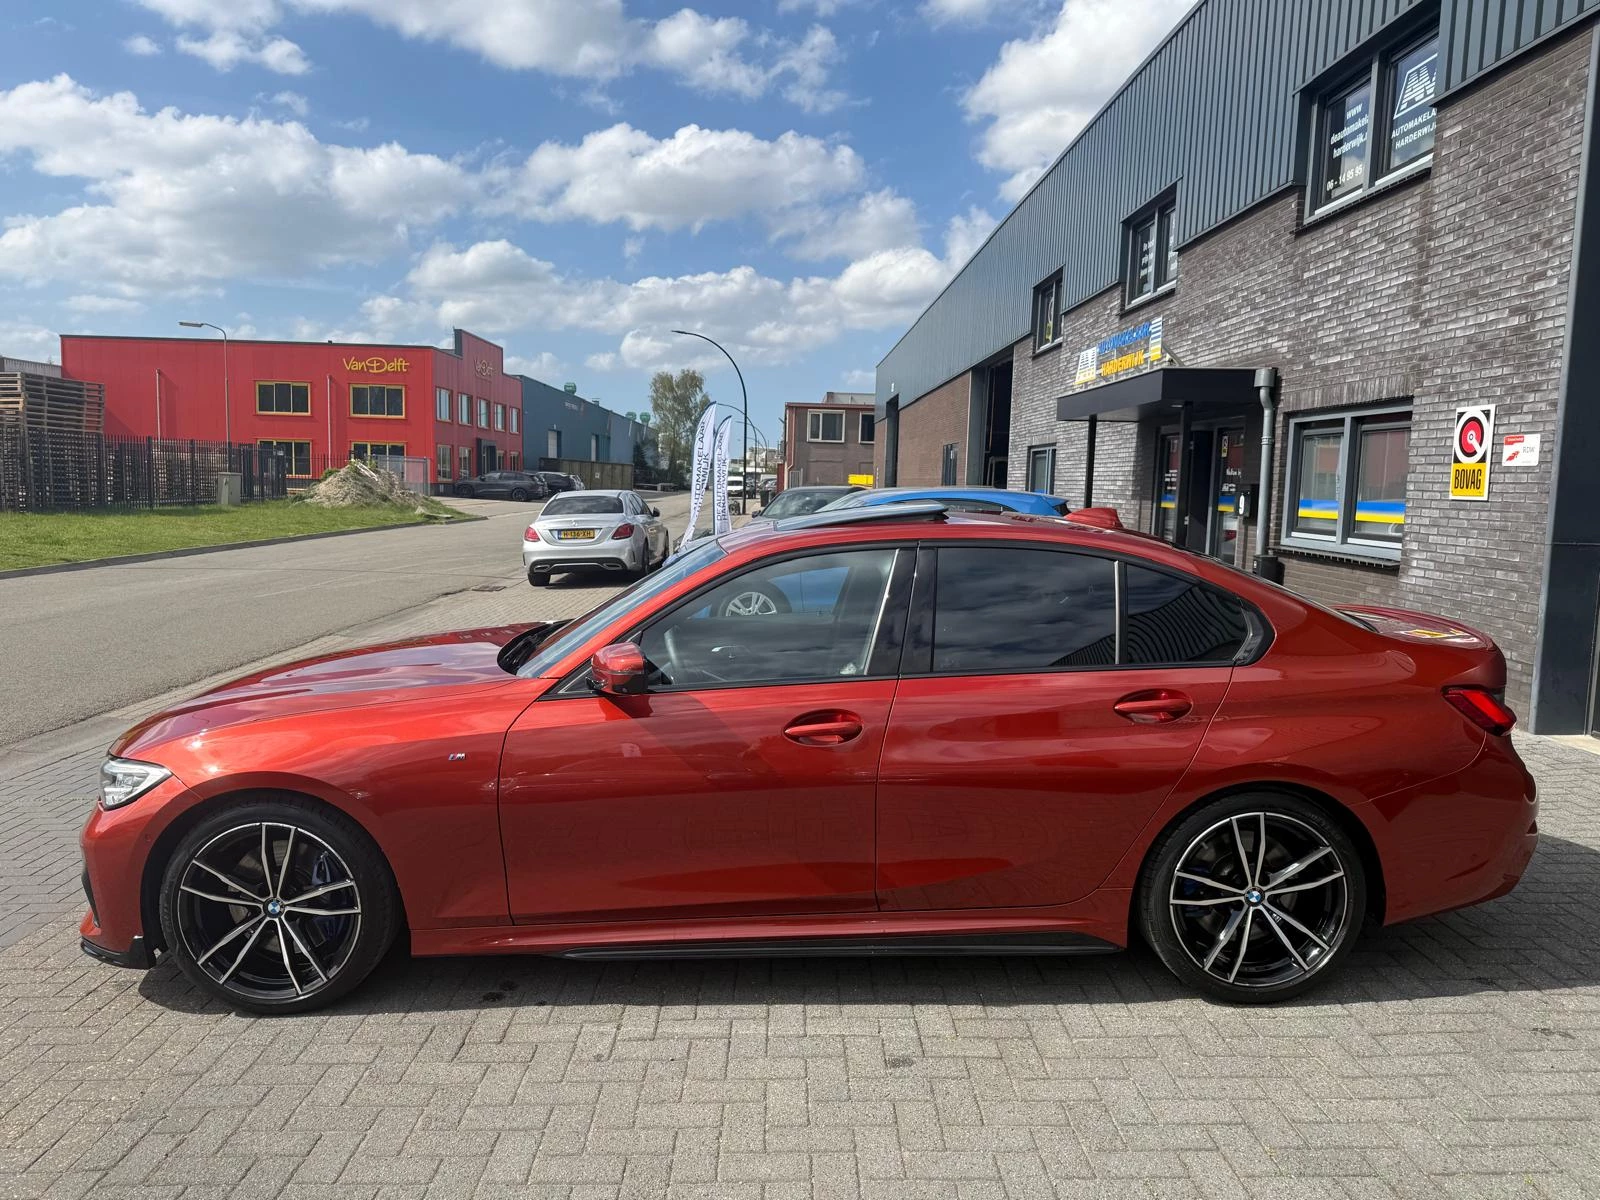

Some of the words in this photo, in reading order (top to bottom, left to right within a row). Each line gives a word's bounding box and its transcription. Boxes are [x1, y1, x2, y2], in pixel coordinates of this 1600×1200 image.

[1391, 108, 1437, 139] AUTOMAKELA
[1395, 122, 1437, 150] HARDERWIJ
[1101, 349, 1145, 377] HARDERWIJK
[1454, 468, 1482, 490] BOVAG
[1239, 495, 1245, 515] 9
